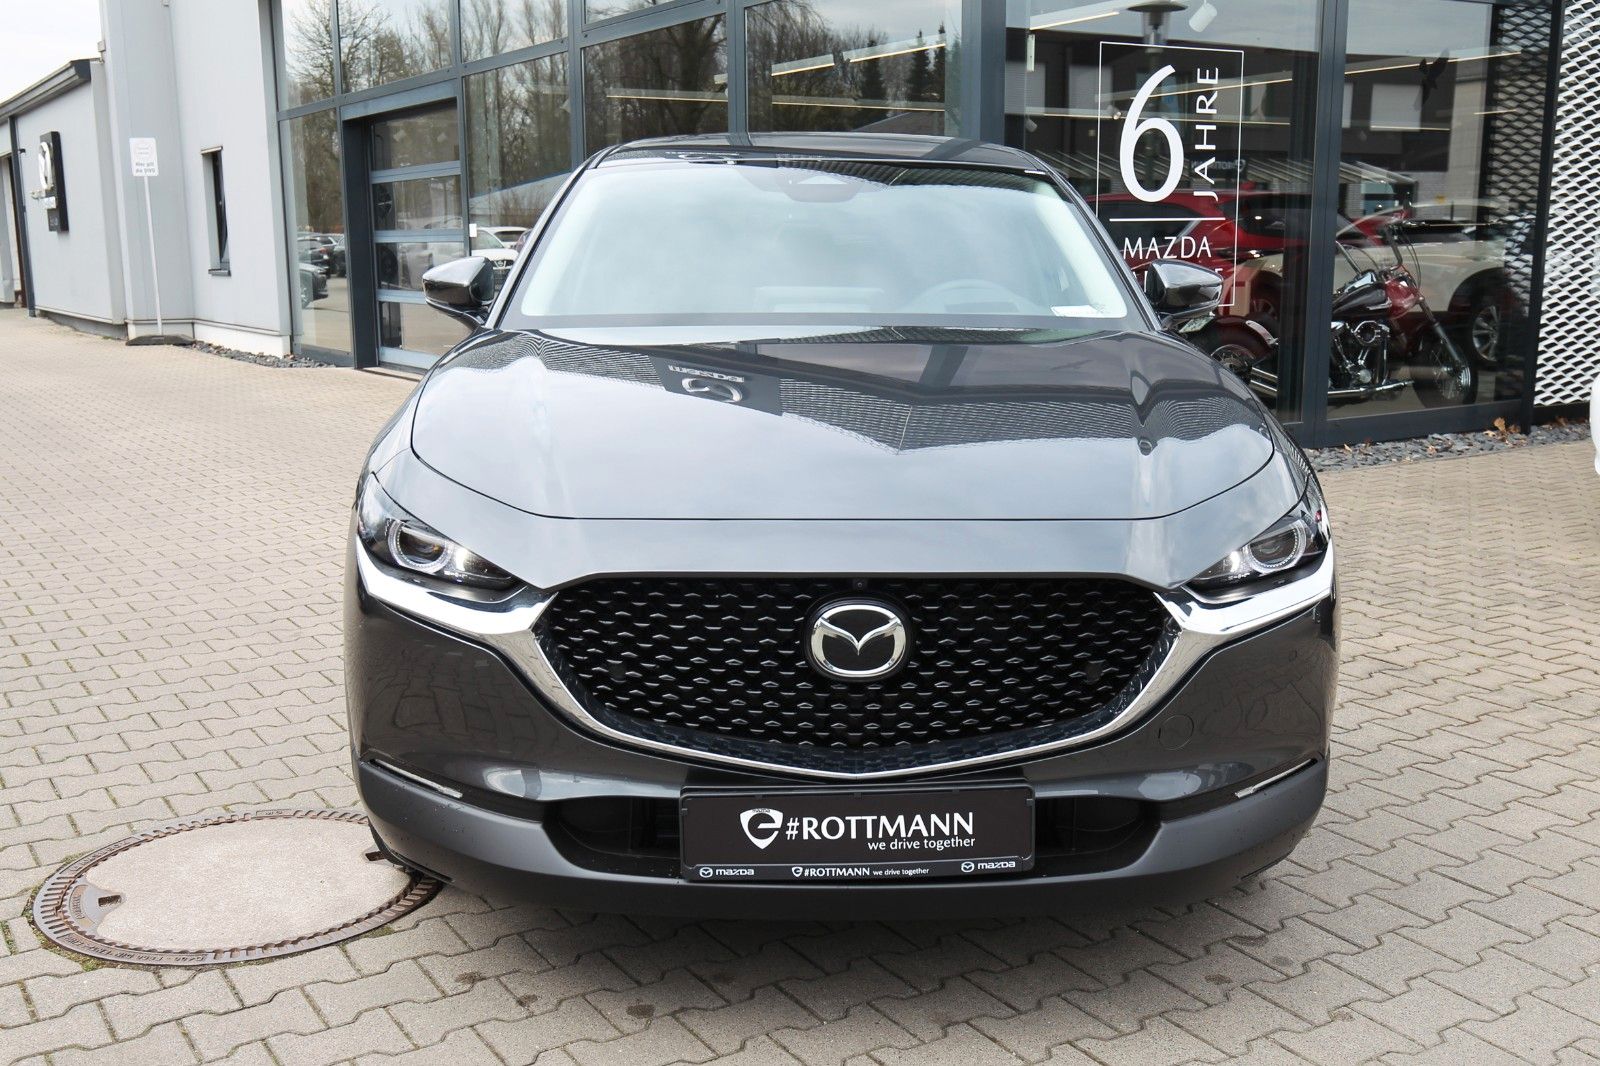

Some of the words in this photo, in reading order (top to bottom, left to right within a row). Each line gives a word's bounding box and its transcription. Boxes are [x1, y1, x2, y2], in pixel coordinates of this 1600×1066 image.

[1119, 64, 1184, 203] 6
[1193, 66, 1219, 202] JAHRE
[1123, 236, 1212, 260] MAZDA
[785, 811, 974, 841] #ROTTMANN
[867, 841, 886, 851] we
[889, 838, 920, 850] drive
[923, 836, 976, 851] together
[715, 868, 755, 877] mazda
[804, 867, 870, 877] #ROTTMANN
[901, 867, 930, 877] together
[977, 861, 1016, 870] mazda
